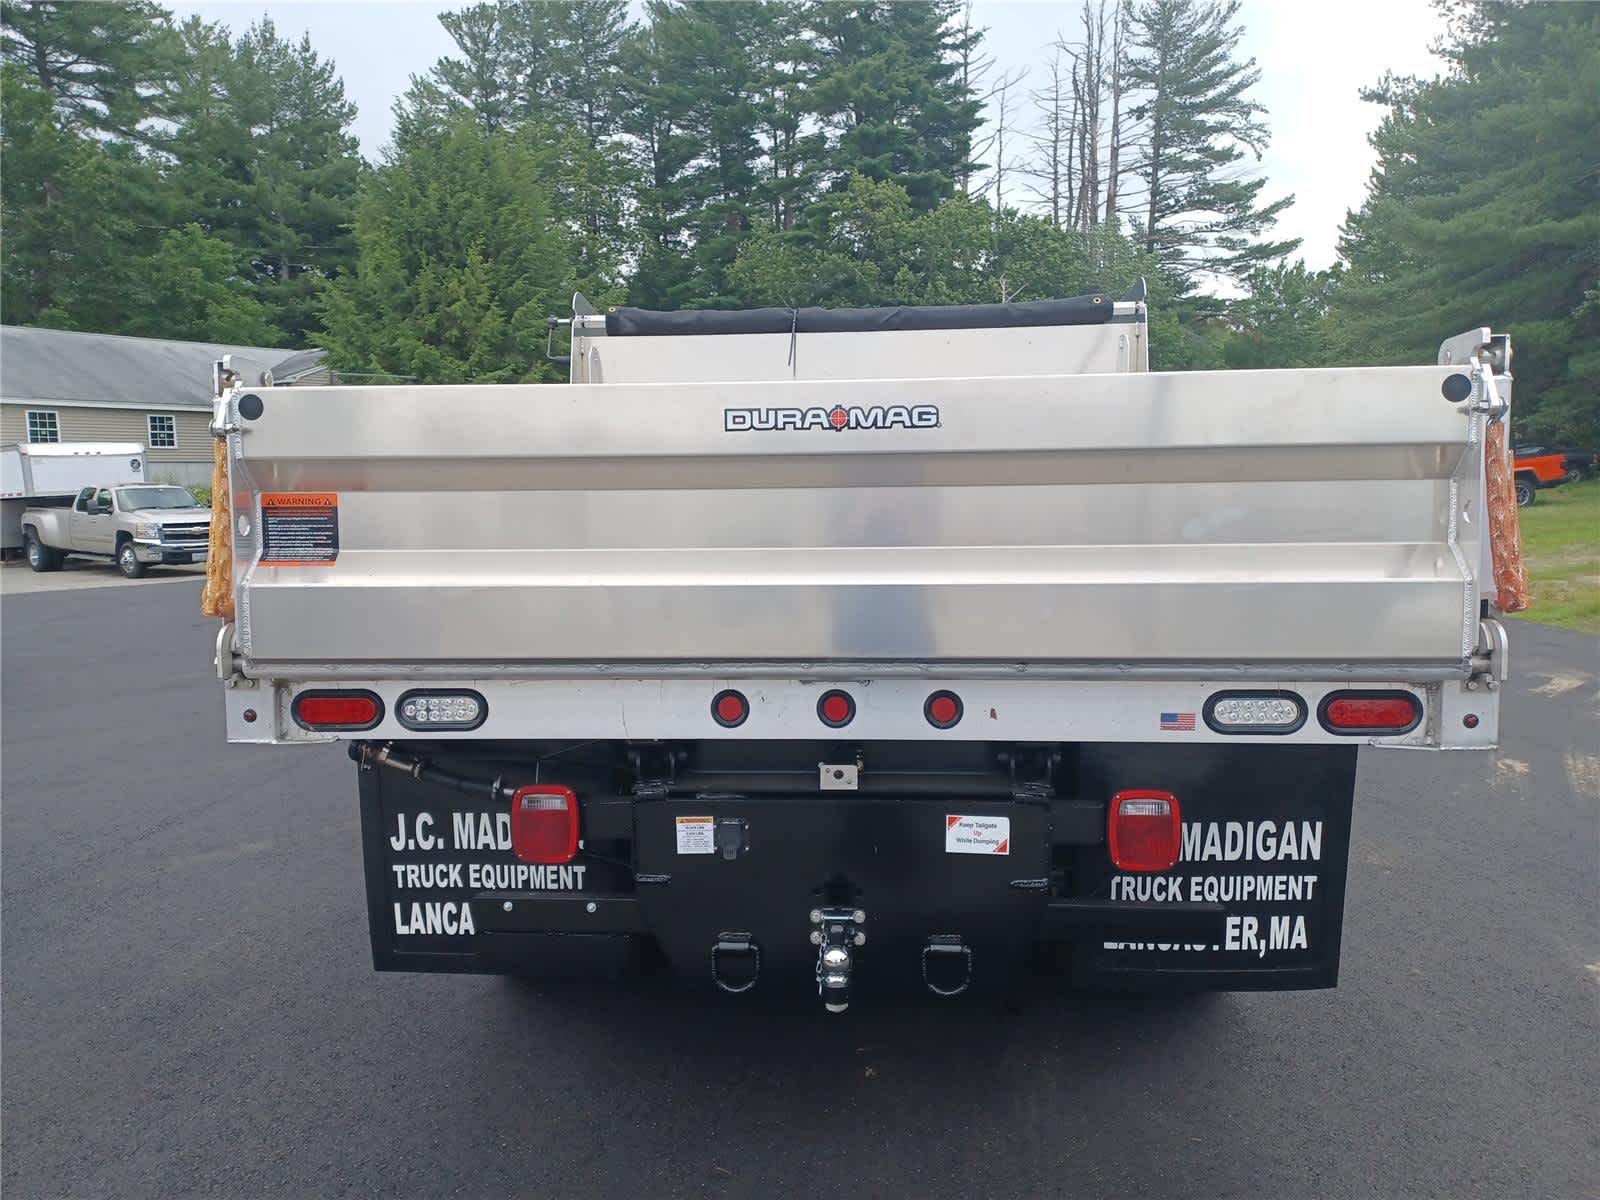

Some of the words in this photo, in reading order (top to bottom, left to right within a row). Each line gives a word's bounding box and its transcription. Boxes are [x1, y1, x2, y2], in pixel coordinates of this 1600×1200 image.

[390, 812, 444, 851] J.C.
[975, 822, 998, 830] Tailgate
[973, 838, 1000, 846] Dumping
[1179, 820, 1323, 861] MADIGAN
[392, 863, 464, 889] TRUCK
[469, 863, 586, 890] EQUIPMENT
[1190, 875, 1318, 903] EQUIPMENT
[394, 902, 475, 936] LANCA
